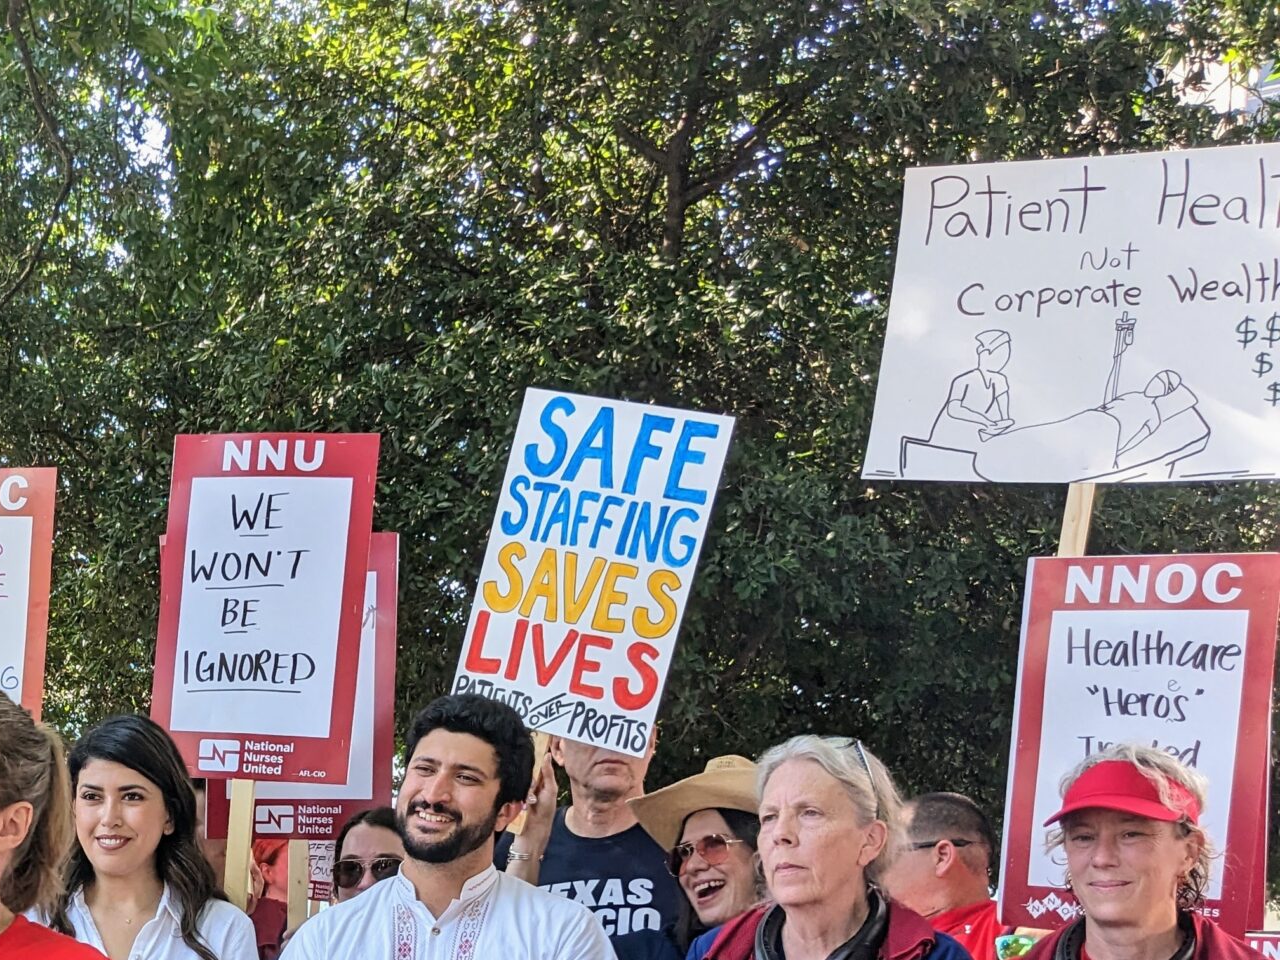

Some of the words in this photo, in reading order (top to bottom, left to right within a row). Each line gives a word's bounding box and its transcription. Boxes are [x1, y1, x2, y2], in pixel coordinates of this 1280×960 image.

[924, 164, 1107, 246] Patient
[1080, 241, 1140, 271] Not
[956, 278, 1142, 318] Corporate
[221, 439, 326, 472] NNU
[524, 396, 719, 506] SAFE
[231, 491, 290, 531] WE
[500, 474, 700, 568] STAFFING
[191, 548, 311, 583] WON'T
[1064, 562, 1244, 604] NNOC
[483, 541, 682, 639] SAVES
[221, 597, 261, 629] BE
[183, 648, 317, 686] IGNORED
[465, 610, 660, 711] LIVES
[1067, 626, 1242, 672] Healthcare
[529, 699, 572, 727] OVER
[567, 700, 647, 754] PROFITS
[244, 740, 295, 754] National
[244, 752, 284, 765] Nurses
[243, 763, 282, 777] United
[298, 768, 327, 779] AFL-CIO
[297, 804, 342, 815] National
[297, 815, 333, 825] Nurses
[297, 824, 332, 834] United
